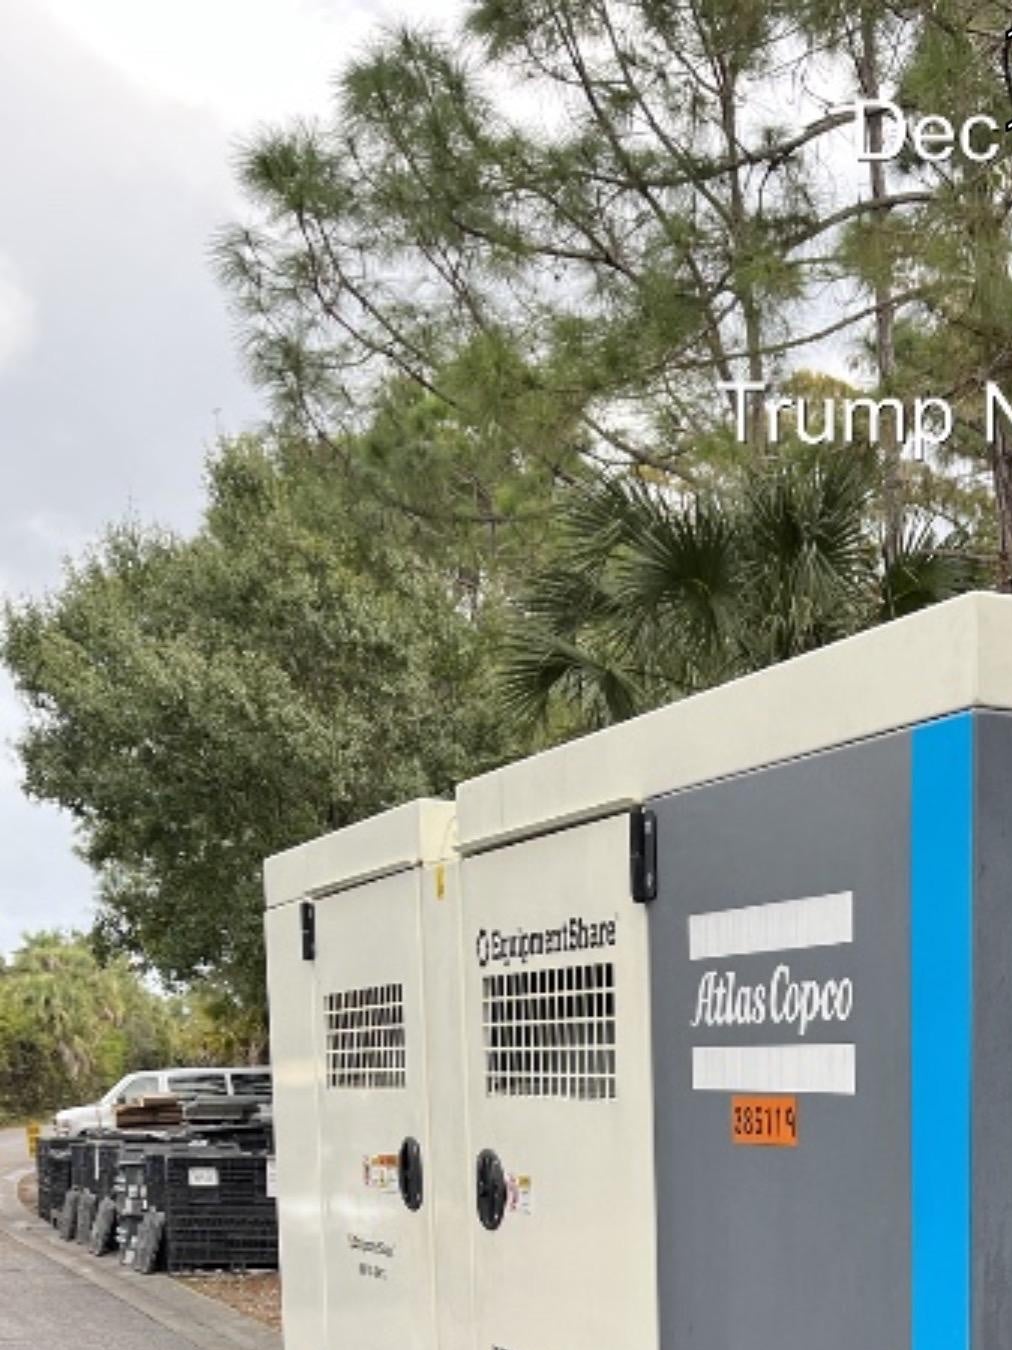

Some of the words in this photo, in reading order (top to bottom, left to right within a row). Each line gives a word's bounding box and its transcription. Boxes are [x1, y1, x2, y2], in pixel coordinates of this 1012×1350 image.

[690, 970, 766, 1027] Atlas
[769, 963, 853, 1036] Copco
[734, 1106, 797, 1138] 385119
